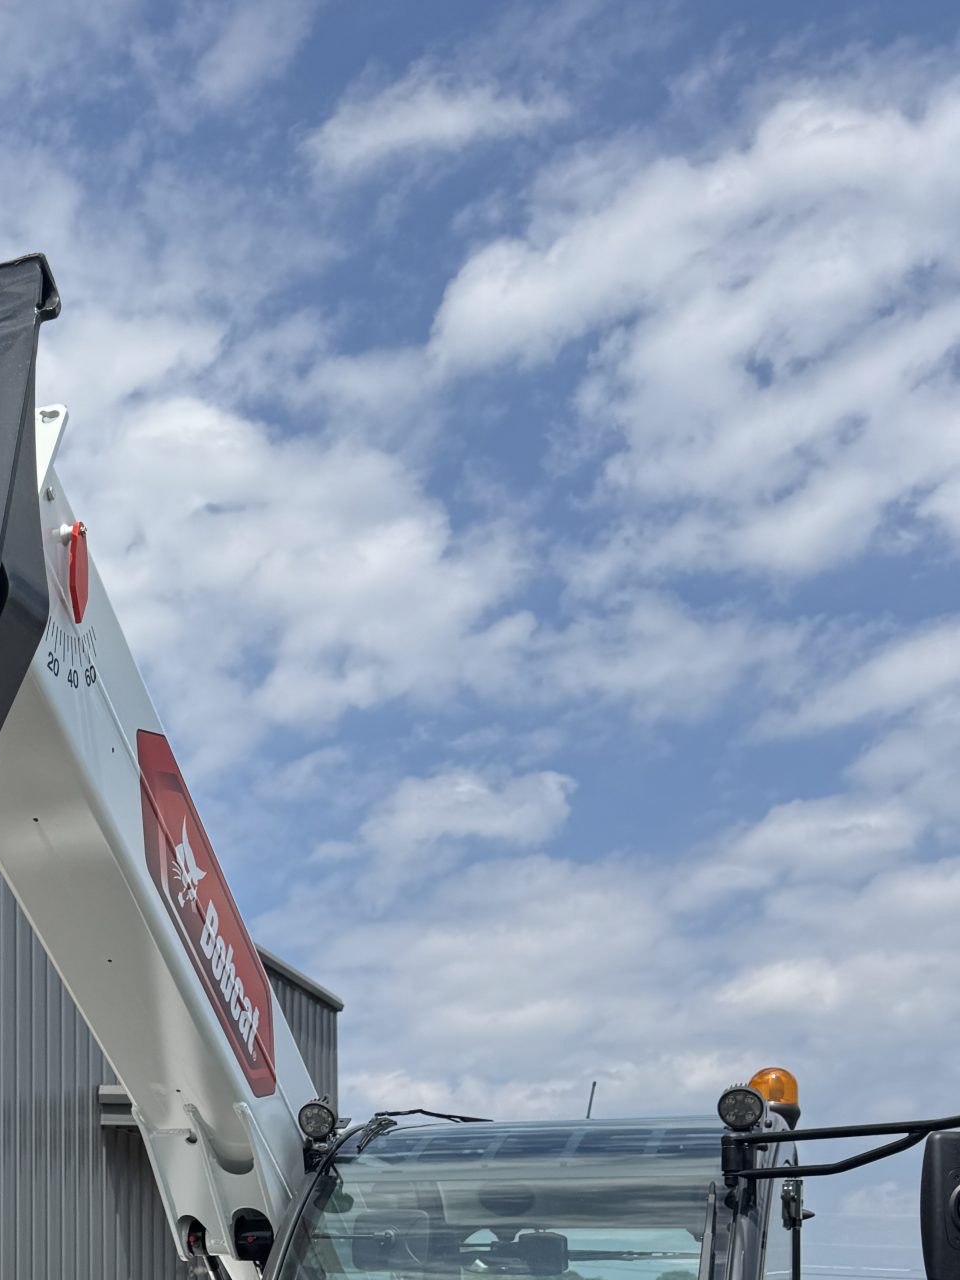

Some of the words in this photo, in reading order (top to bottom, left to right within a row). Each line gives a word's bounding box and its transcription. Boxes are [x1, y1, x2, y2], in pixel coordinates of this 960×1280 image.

[47, 651, 60, 677] 20
[67, 668, 79, 689] 40
[84, 665, 97, 687] 60
[200, 899, 260, 1055] Bobcat
